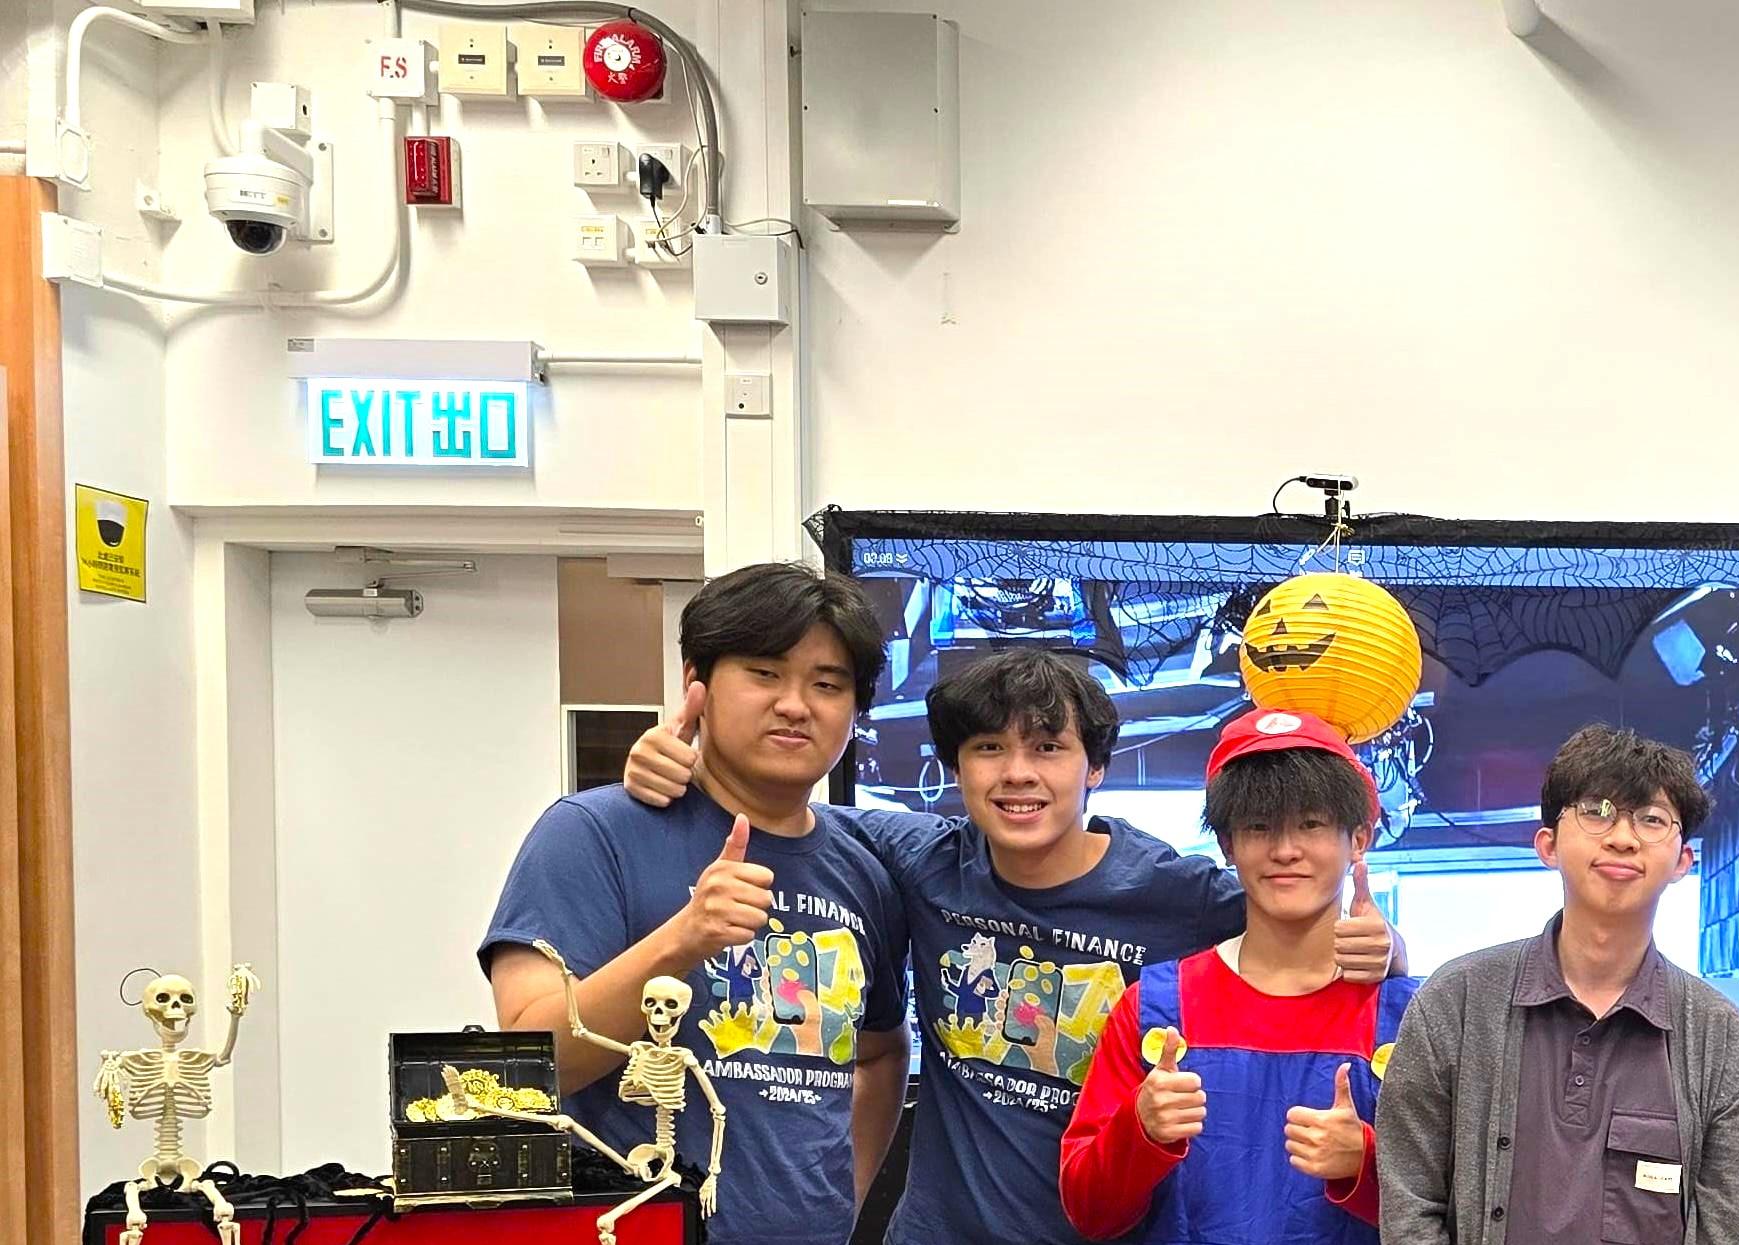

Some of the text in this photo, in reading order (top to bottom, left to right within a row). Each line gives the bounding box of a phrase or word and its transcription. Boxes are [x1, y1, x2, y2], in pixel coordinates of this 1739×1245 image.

[611, 33, 642, 65] ALARM
[321, 389, 517, 459] EXIT 出口
[796, 893, 866, 935] FINANCE
[941, 909, 1147, 965] PERSONAL FINANCE
[703, 1060, 802, 1085] AMBASSADOR
